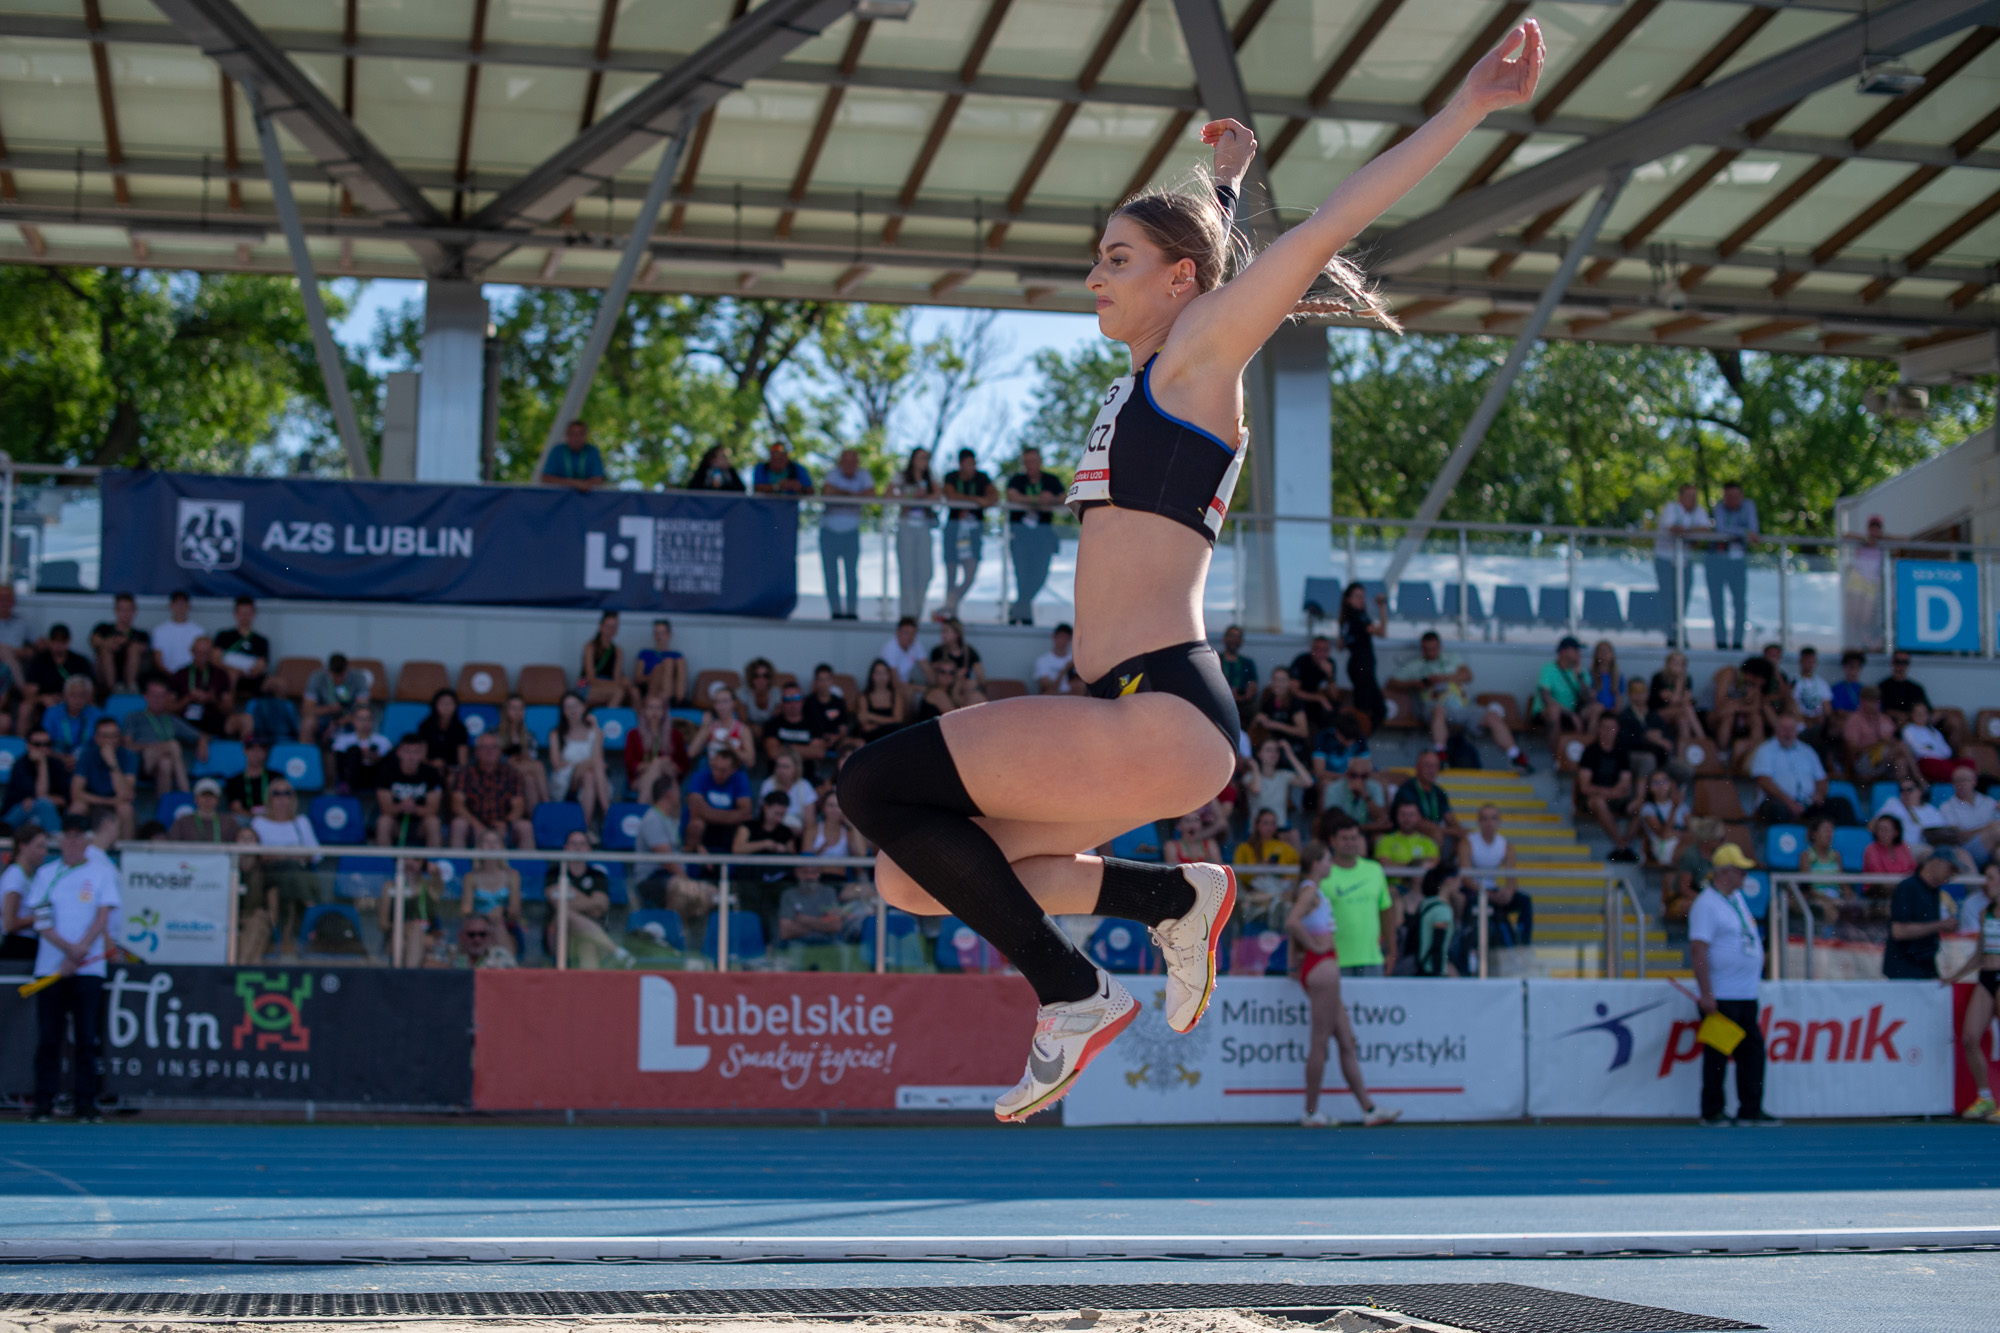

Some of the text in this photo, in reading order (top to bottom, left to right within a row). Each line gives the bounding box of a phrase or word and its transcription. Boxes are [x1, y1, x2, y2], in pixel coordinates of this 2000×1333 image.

[1104, 385, 1120, 406] 3
[1074, 471, 1104, 480] olski U20
[262, 520, 474, 558] AZS LUBLIN
[1916, 585, 1963, 643] D
[128, 864, 194, 890] mosir
[693, 994, 894, 1036] lubelskie
[1221, 999, 1406, 1026] Ministtwo
[1353, 1035, 1467, 1068] urystyki
[1657, 1003, 1907, 1079] planik
[157, 1057, 311, 1083] INSPIRACJI
[719, 1041, 897, 1090] Smakuj życie!
